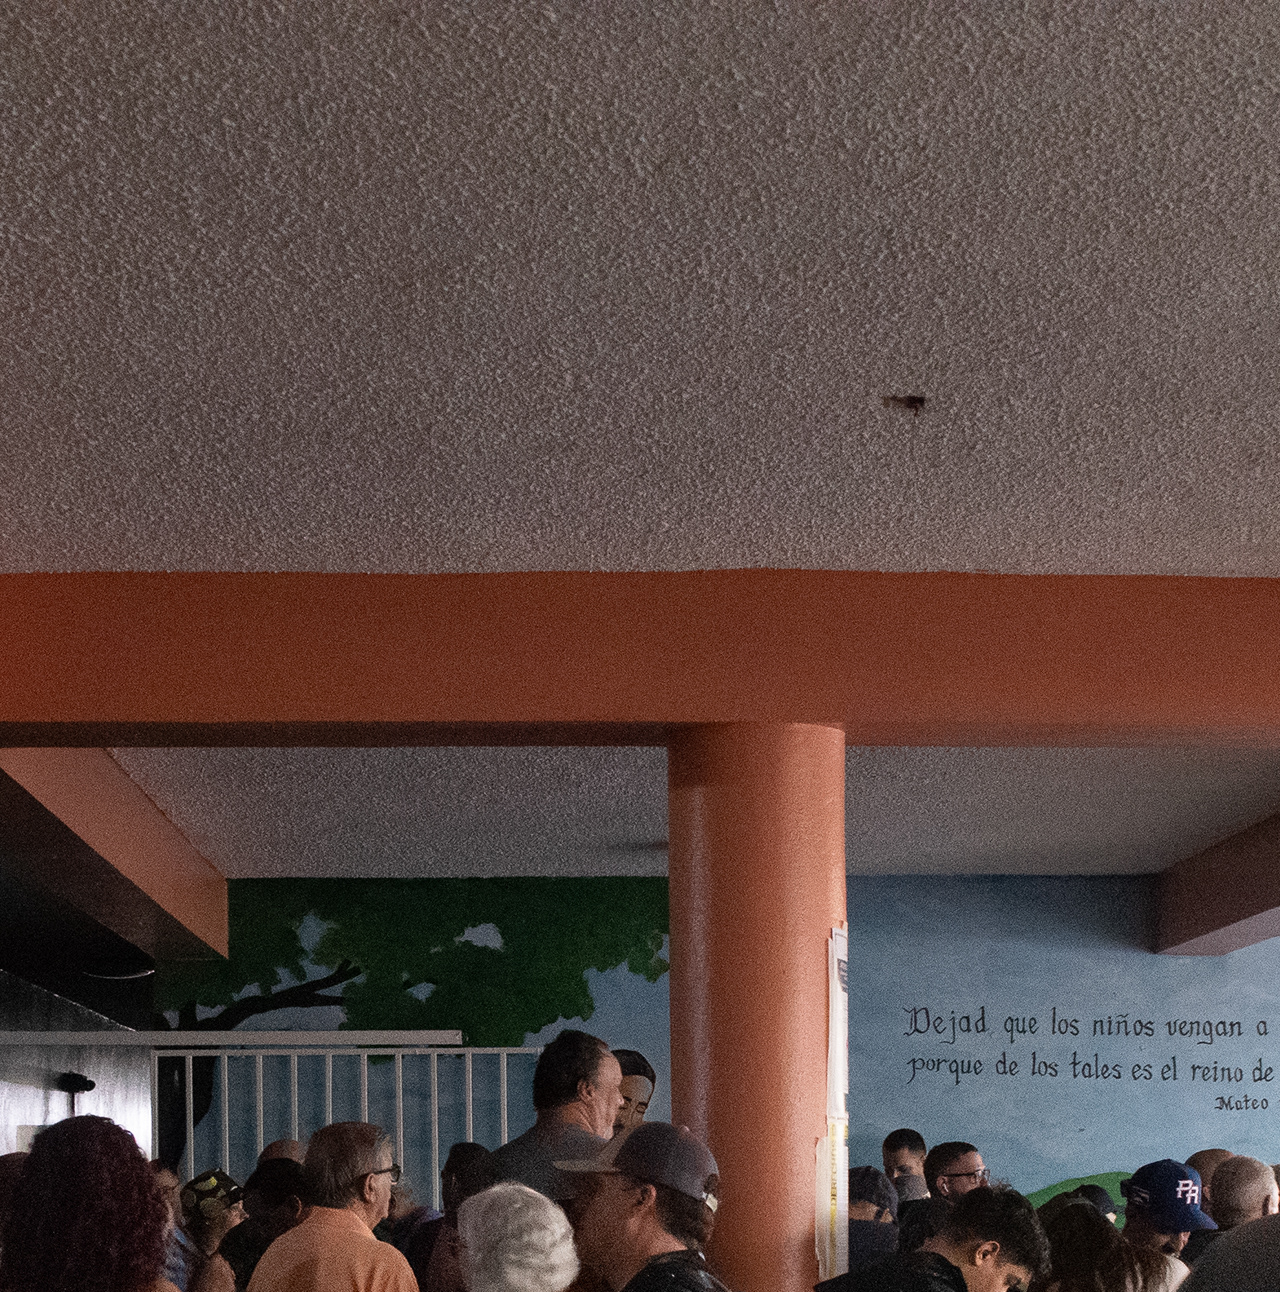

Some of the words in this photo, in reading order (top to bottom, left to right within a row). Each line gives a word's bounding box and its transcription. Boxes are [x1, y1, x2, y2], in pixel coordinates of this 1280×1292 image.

[903, 1006, 990, 1044] Dejad
[1004, 1016, 1039, 1044] que
[1051, 1007, 1080, 1036] los
[1092, 1013, 1155, 1037] niños
[1166, 1019, 1243, 1044] vengan
[1257, 1019, 1269, 1036] a
[907, 1058, 983, 1085] porque
[995, 1052, 1019, 1076] de
[1032, 1052, 1059, 1077] los
[1069, 1051, 1122, 1080] tales
[1131, 1063, 1154, 1080] es
[1161, 1056, 1178, 1081] el
[1191, 1061, 1244, 1082] reino
[1252, 1058, 1275, 1083] de
[1214, 1094, 1269, 1111] Mateo
[1176, 1180, 1199, 1205] PR
